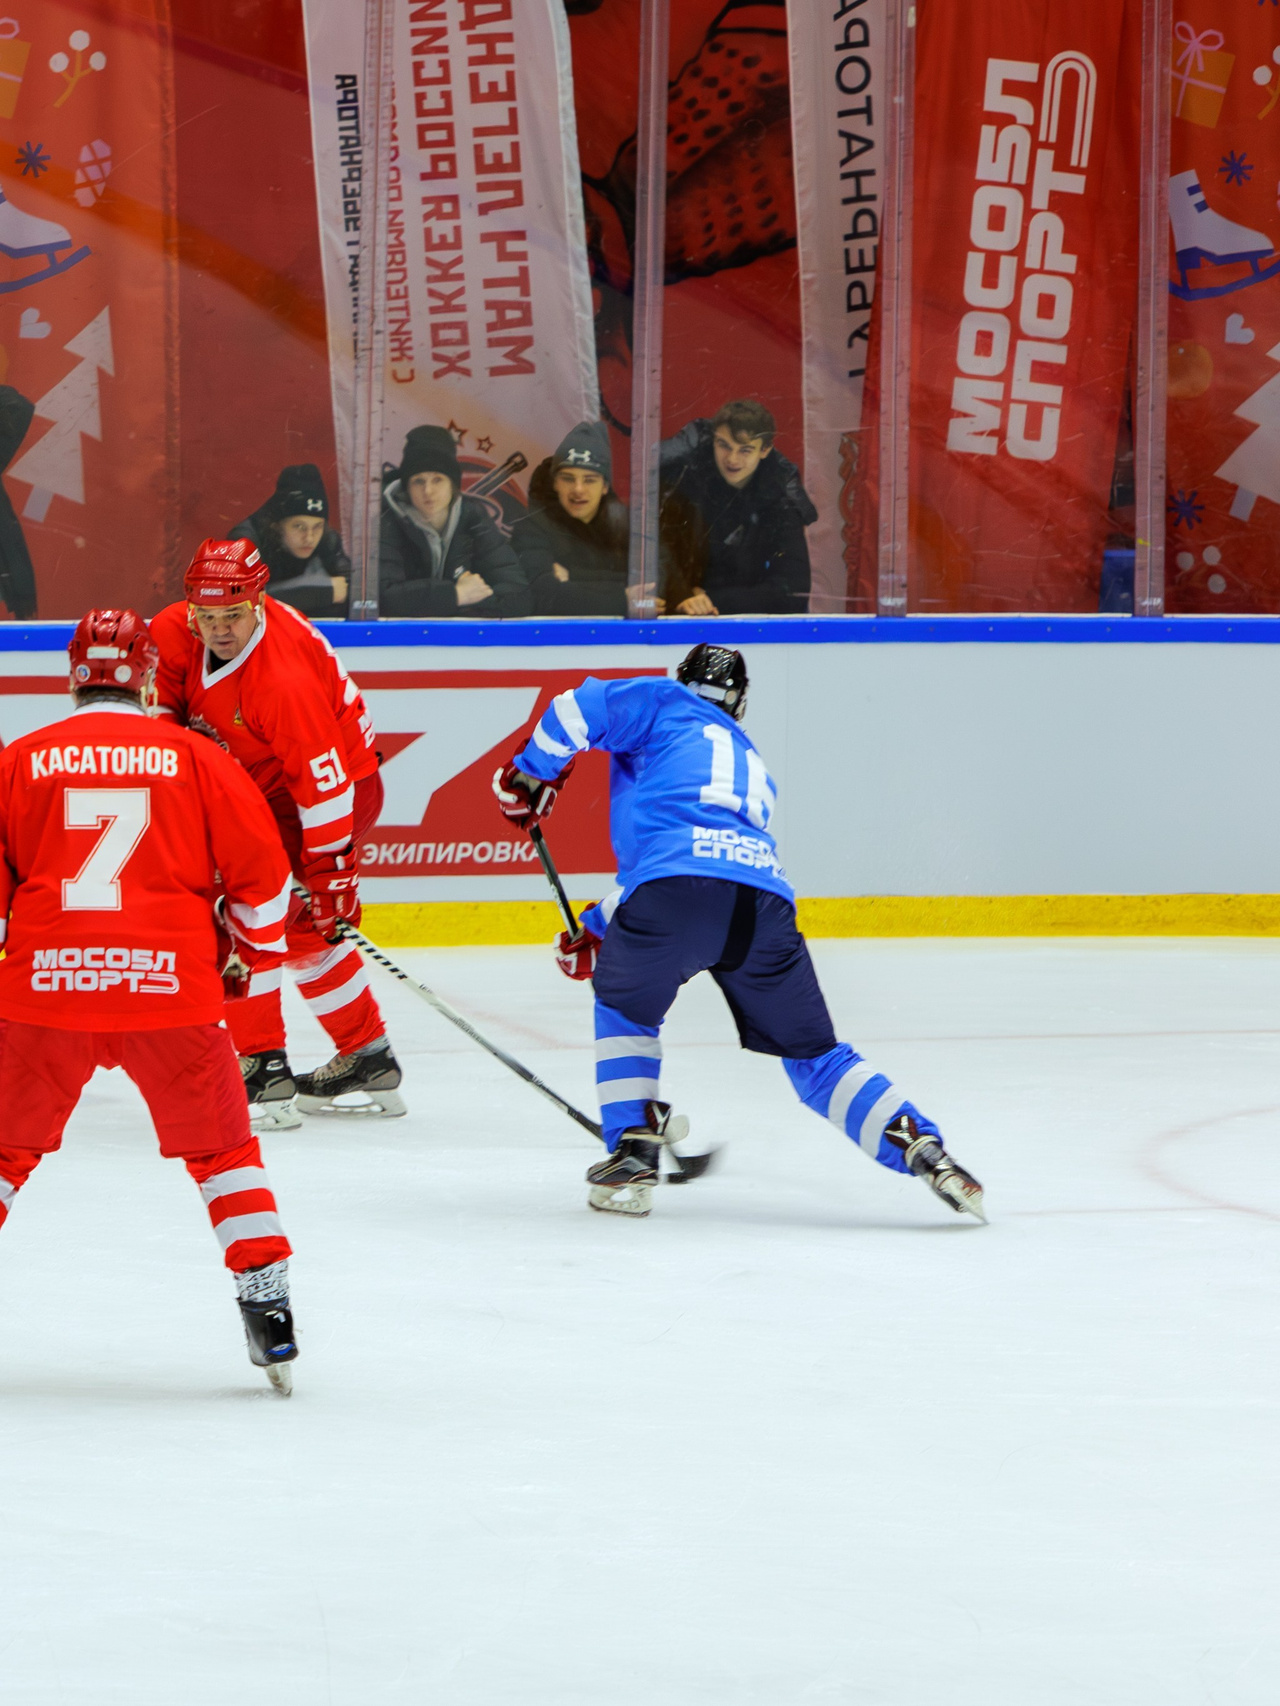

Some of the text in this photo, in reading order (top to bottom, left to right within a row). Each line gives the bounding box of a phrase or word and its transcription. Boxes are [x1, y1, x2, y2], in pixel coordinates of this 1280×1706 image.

[946, 58, 1040, 456] МОСОБЛ
[1006, 149, 1086, 461] СПОРТ
[31, 745, 178, 780] КАСАТОНОВ
[309, 746, 347, 793] 51
[62, 787, 151, 911] 7
[31, 970, 145, 993] СПОРТ
[32, 947, 176, 972] МОСОБЛ
